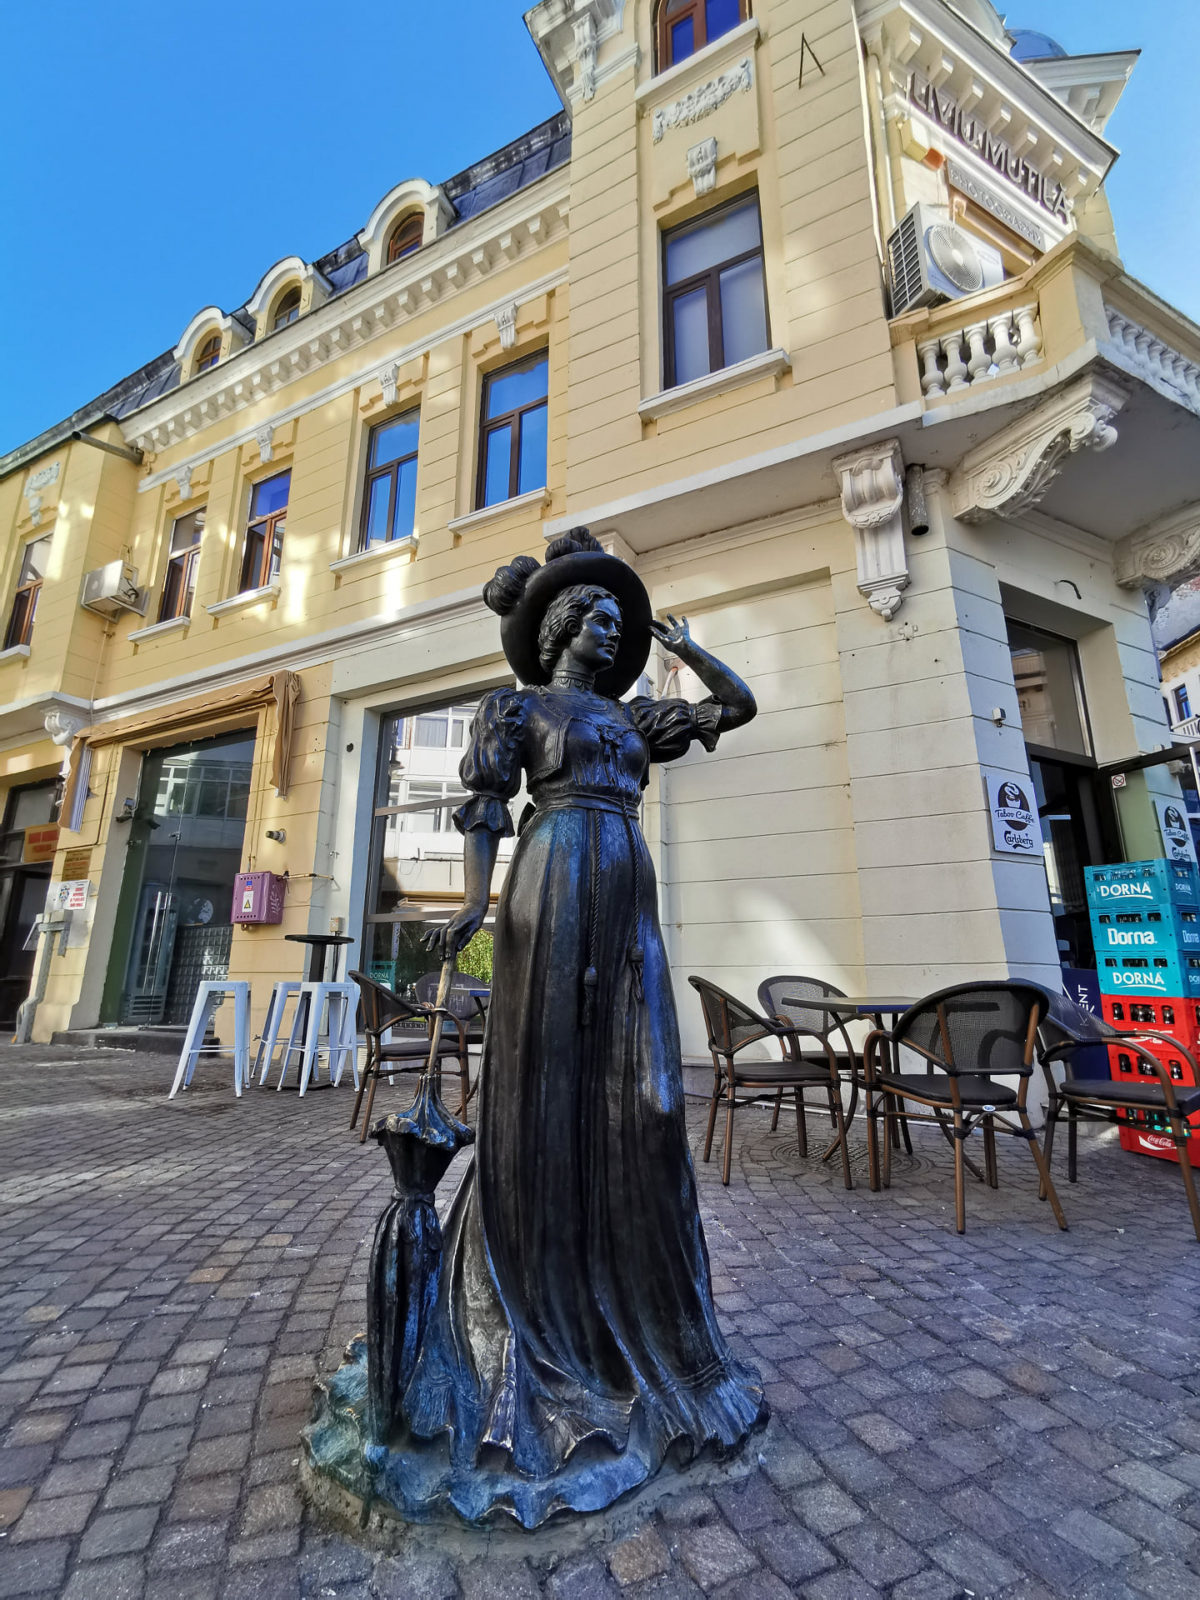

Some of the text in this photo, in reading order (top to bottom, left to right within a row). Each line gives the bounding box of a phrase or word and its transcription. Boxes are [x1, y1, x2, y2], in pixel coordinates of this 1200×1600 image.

[984, 128, 1071, 226] MUTILĂ
[950, 168, 1042, 245] PHOTOGRAPHY
[1003, 830, 1034, 849] Carlsberg
[1100, 882, 1152, 897] DORNA
[1175, 883, 1192, 892] DORNA
[1107, 928, 1155, 945] Dorna
[1182, 929, 1200, 943] Dorna
[1112, 971, 1165, 985] DORNA
